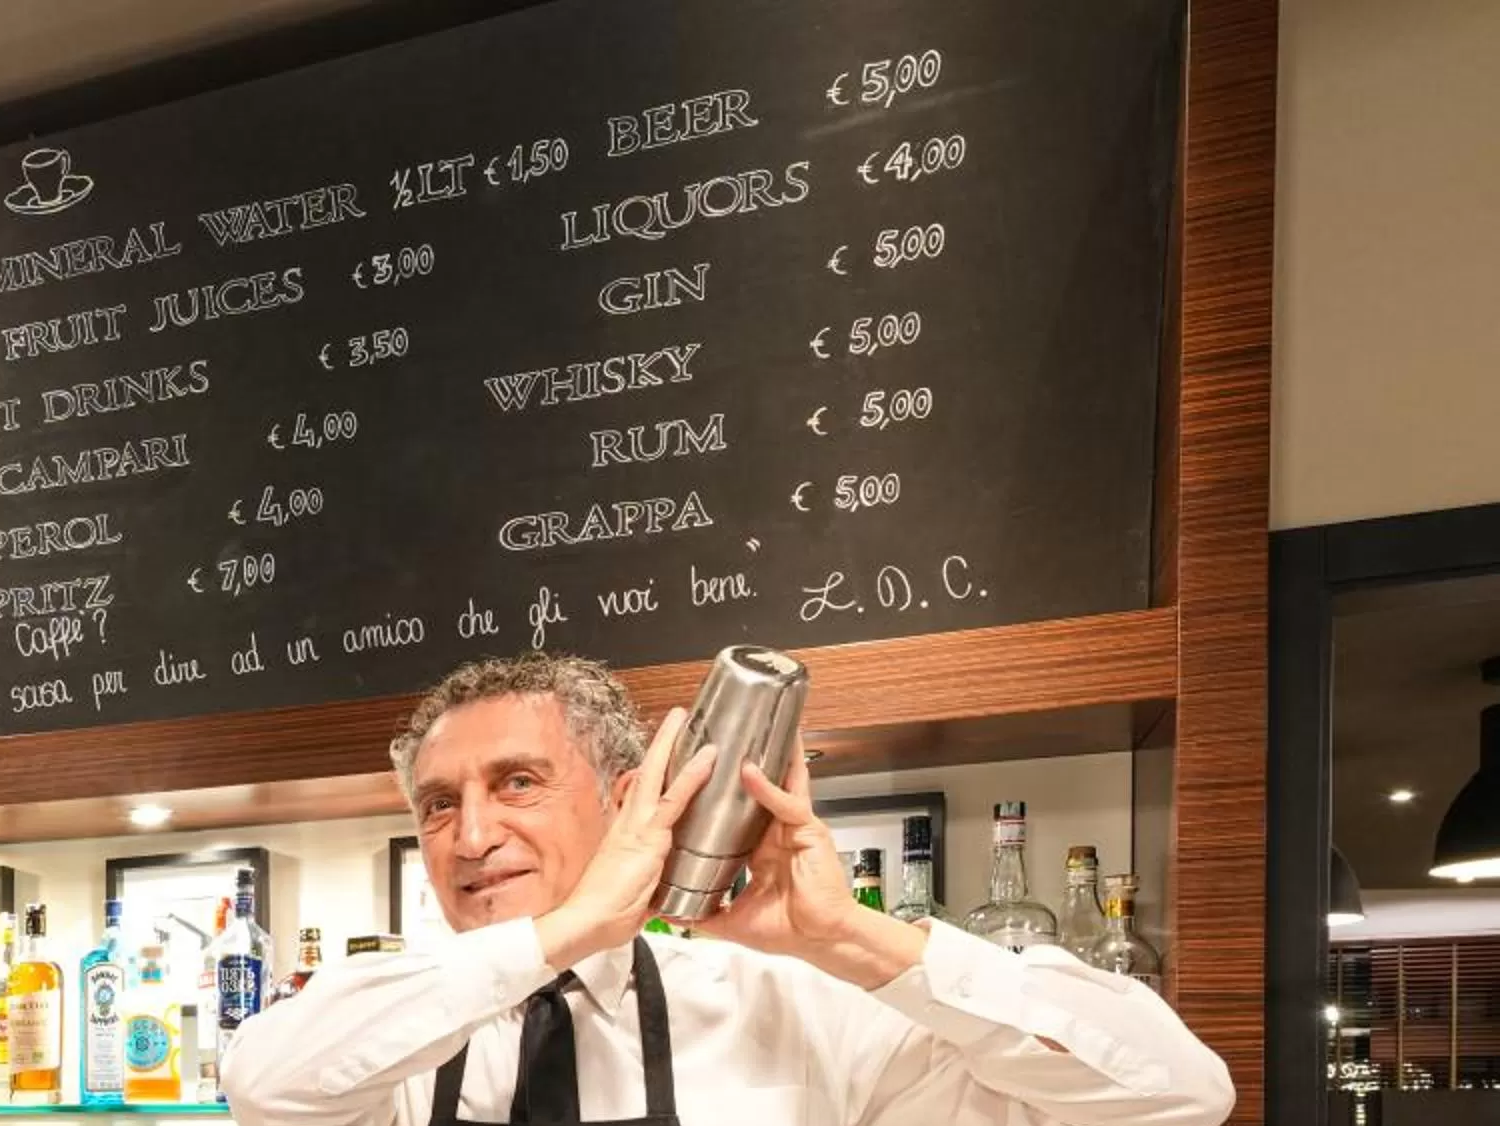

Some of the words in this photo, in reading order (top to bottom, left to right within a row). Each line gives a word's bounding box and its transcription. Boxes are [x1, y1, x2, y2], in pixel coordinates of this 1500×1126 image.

[608, 88, 759, 157] BEER
[198, 182, 367, 248] WATER
[561, 161, 811, 250] LIQUORS
[3, 303, 127, 361] FRUIT
[149, 266, 305, 334] JUICES
[599, 263, 710, 315] GIN
[41, 360, 211, 424] DRINKS
[484, 342, 702, 412] WHISKY
[589, 412, 728, 468] RUM
[499, 490, 715, 552] GRAPPA
[9, 678, 73, 714] scusa
[153, 649, 208, 686] dire
[230, 632, 266, 676] ad
[286, 636, 321, 666] un
[342, 613, 425, 654] amico
[457, 597, 500, 640] che
[528, 585, 569, 650] gli
